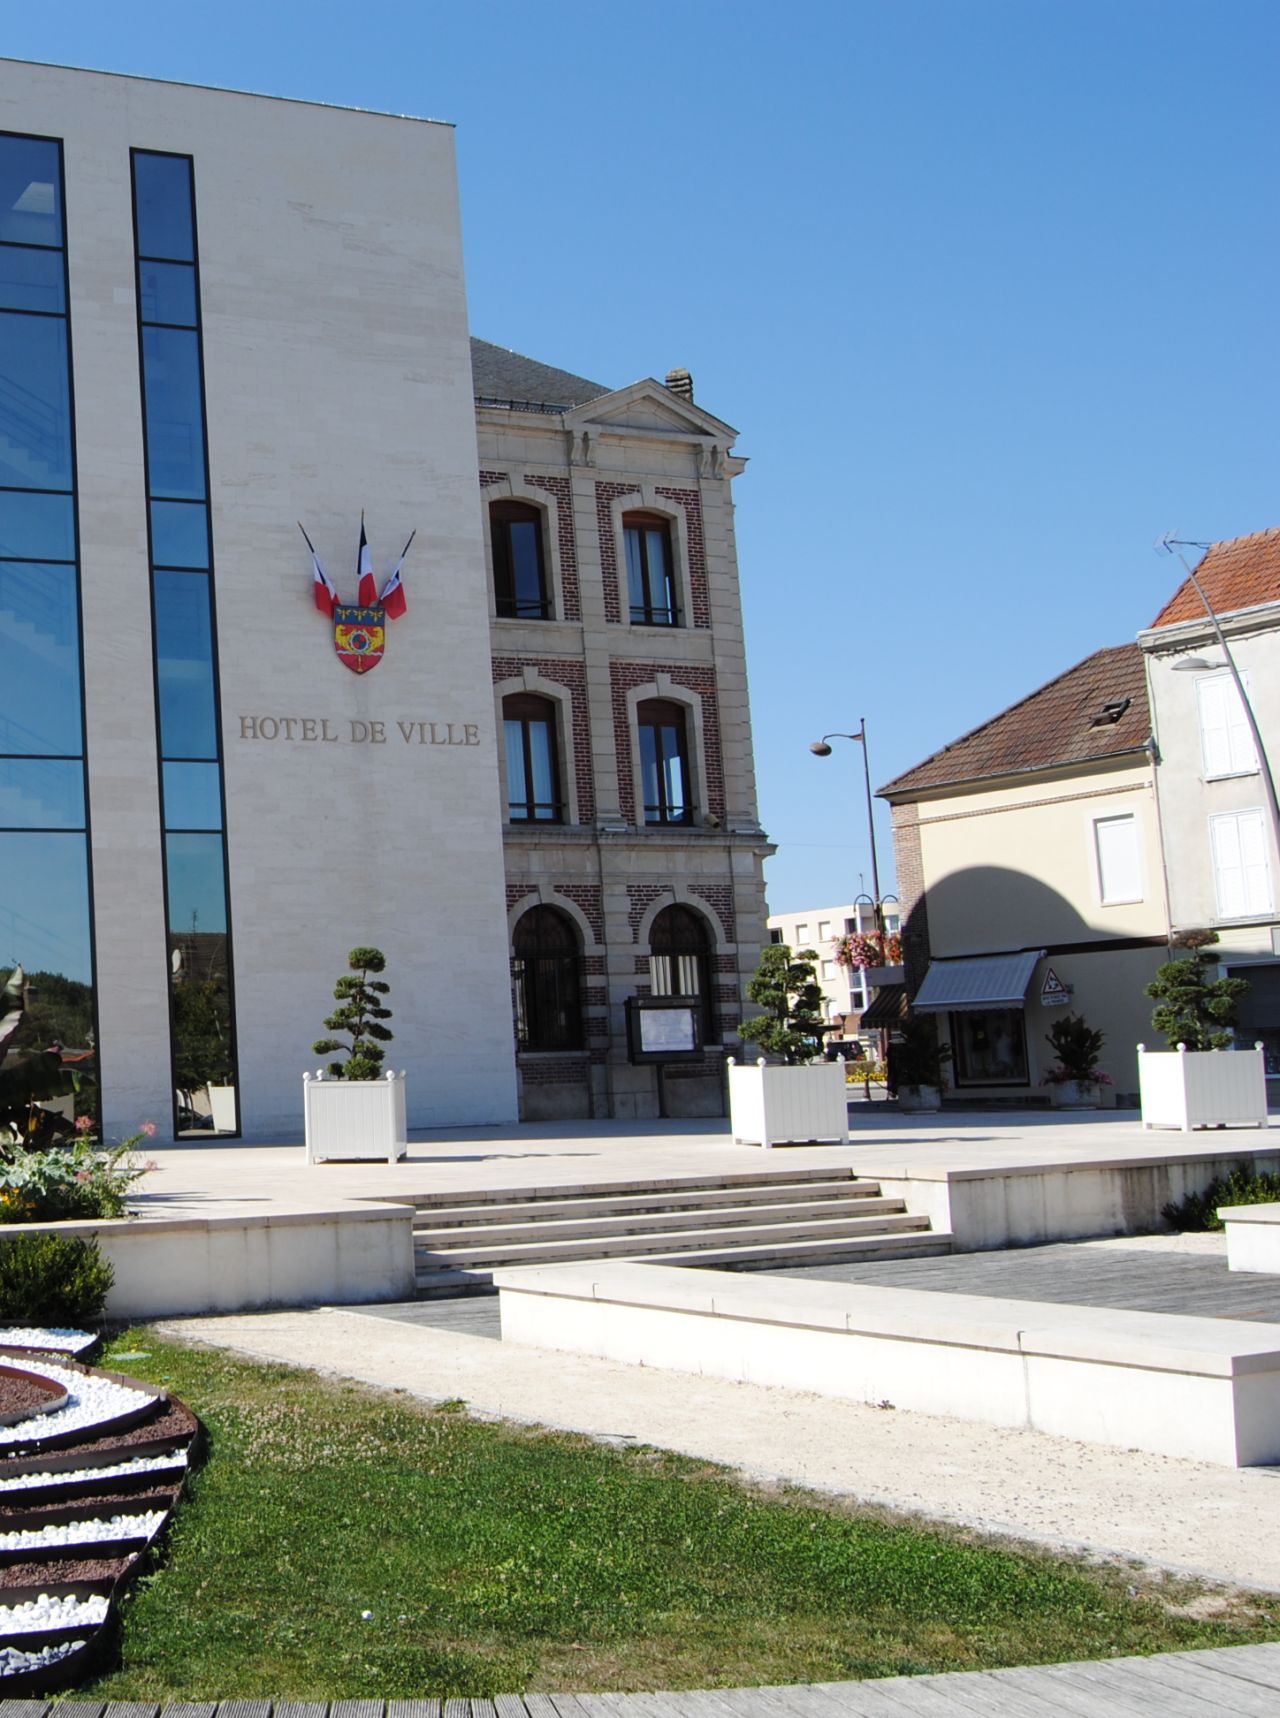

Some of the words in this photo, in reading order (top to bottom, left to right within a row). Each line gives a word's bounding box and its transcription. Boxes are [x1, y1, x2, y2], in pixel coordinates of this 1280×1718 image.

[238, 716, 339, 743] HOTEL
[349, 720, 387, 744] DE
[396, 721, 481, 746] VILLE
